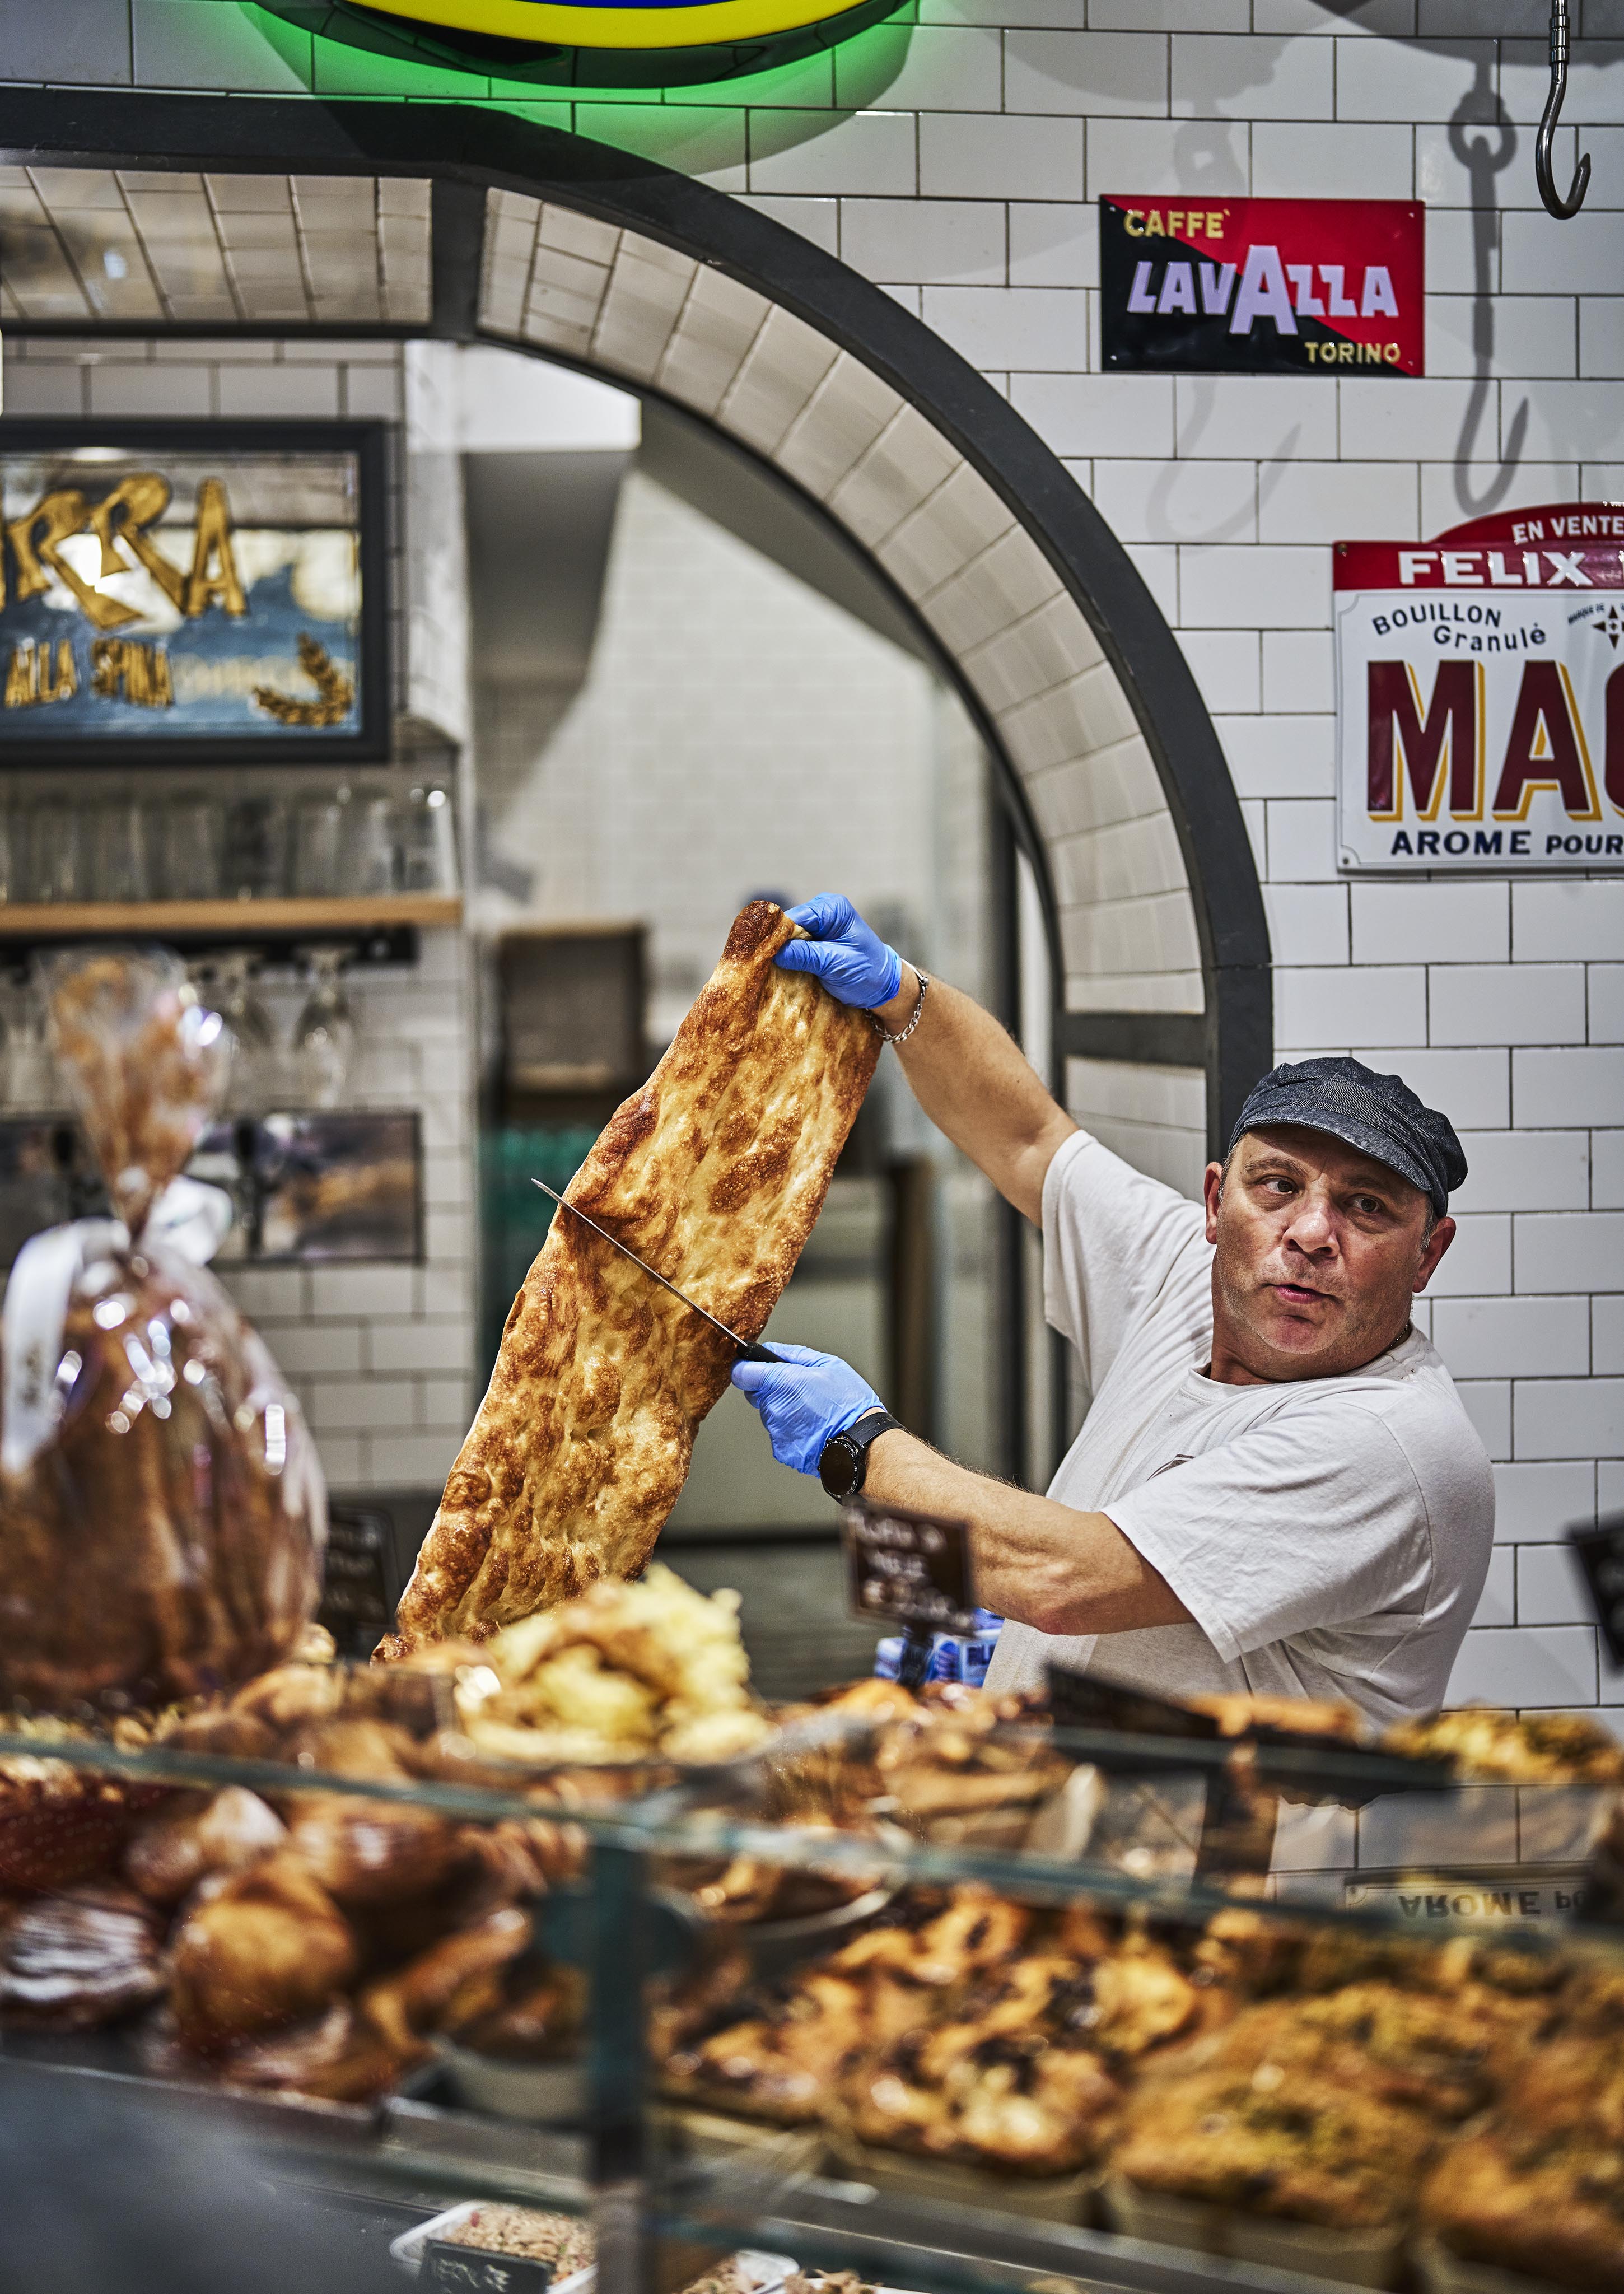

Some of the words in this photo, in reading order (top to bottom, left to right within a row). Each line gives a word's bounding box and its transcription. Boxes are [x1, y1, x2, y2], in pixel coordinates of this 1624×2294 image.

[1127, 245, 1399, 335] LAVAZZA
[1304, 341, 1401, 364] TORINO
[1512, 519, 1544, 545] EN
[1550, 514, 1624, 538] VENTE
[1398, 550, 1594, 587] FELIX
[1372, 603, 1501, 636] BOUILLON
[1433, 622, 1547, 652] Granulé
[1390, 830, 1532, 856] AROME
[1546, 834, 1624, 855] POUR
